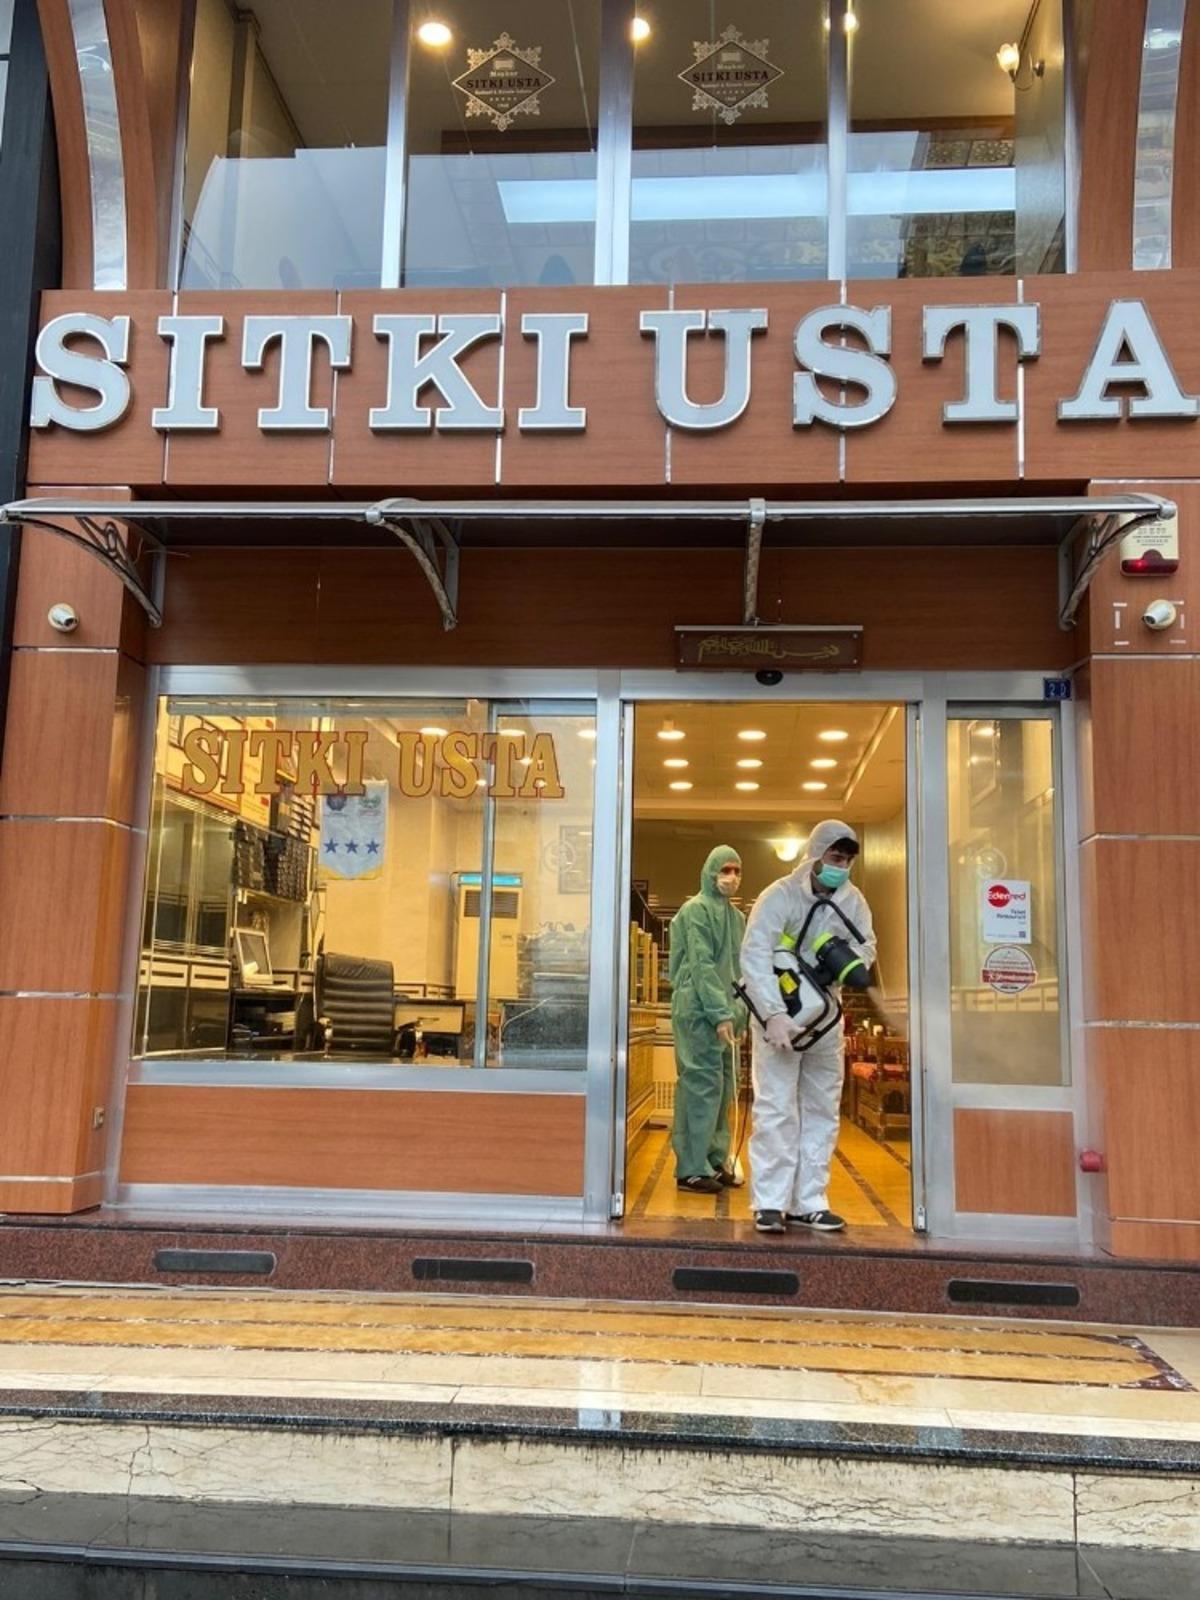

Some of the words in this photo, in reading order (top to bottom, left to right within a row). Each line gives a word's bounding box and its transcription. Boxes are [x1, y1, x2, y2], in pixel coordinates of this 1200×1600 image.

[466, 78, 504, 89] SITKI
[508, 77, 541, 88] USTA
[692, 71, 731, 82] SITKI
[735, 70, 769, 81] USTA
[30, 312, 590, 431] SITKI
[640, 299, 1200, 431] USTA
[181, 727, 369, 797] SITKI
[397, 731, 565, 799] USTA
